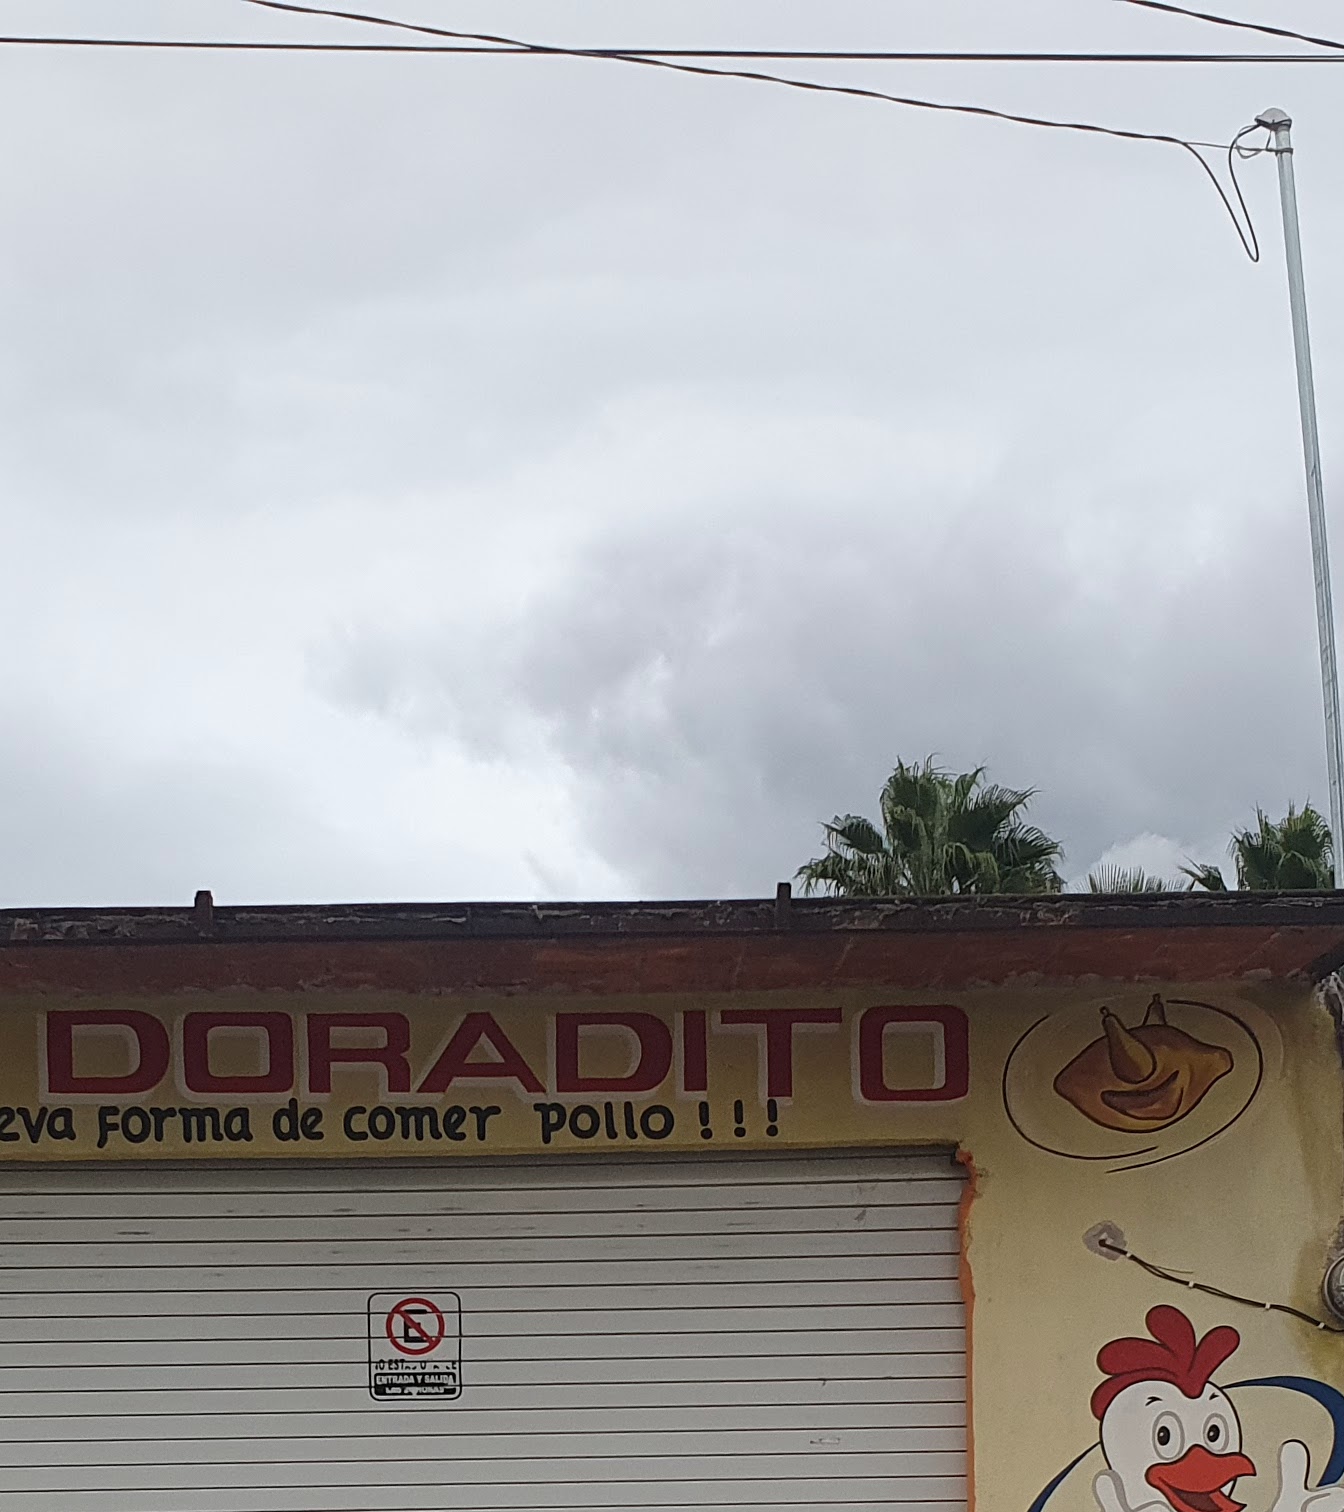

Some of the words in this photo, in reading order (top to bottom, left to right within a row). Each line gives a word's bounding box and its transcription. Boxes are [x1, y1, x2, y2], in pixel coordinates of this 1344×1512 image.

[43, 1004, 969, 1099] DORADITO
[272, 1097, 324, 1141] de
[343, 1104, 502, 1141] comer
[416, 1375, 422, 1384] Y
[424, 1374, 454, 1385] SALIDA
